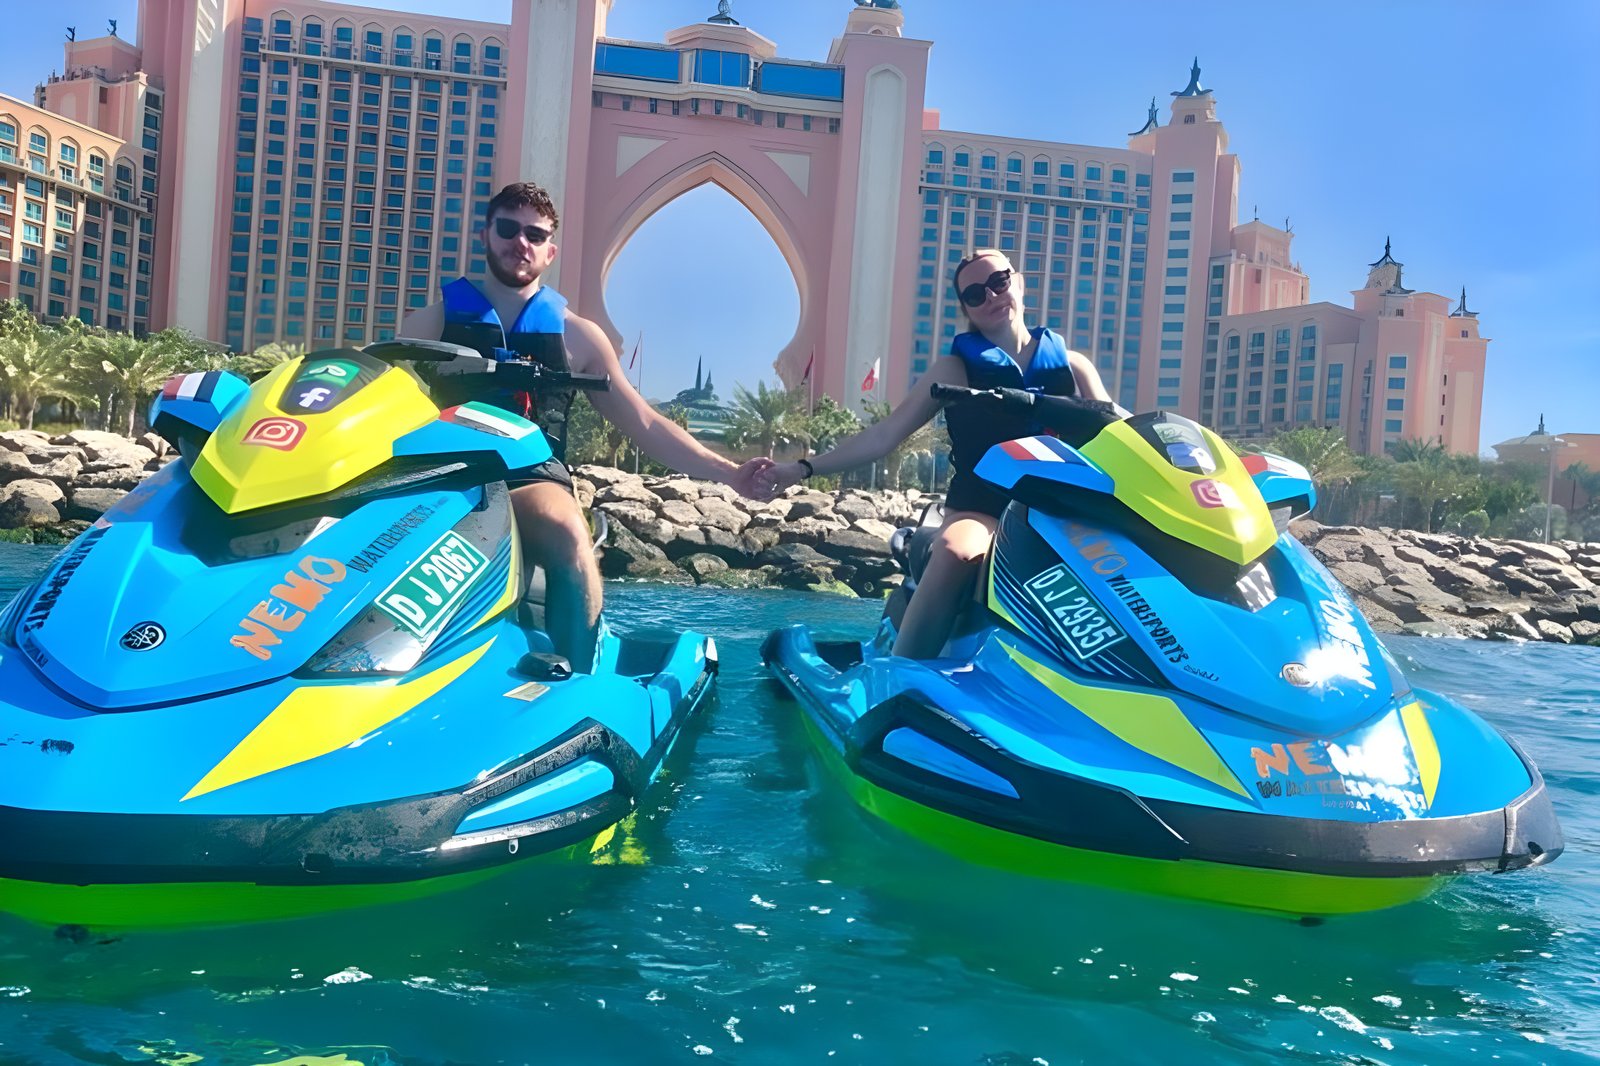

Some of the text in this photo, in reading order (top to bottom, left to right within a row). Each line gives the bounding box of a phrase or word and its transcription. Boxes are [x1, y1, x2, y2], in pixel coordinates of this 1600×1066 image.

[420, 537, 479, 594] 2067
[230, 555, 347, 661] NEMO
[1053, 596, 1117, 649] 2935
